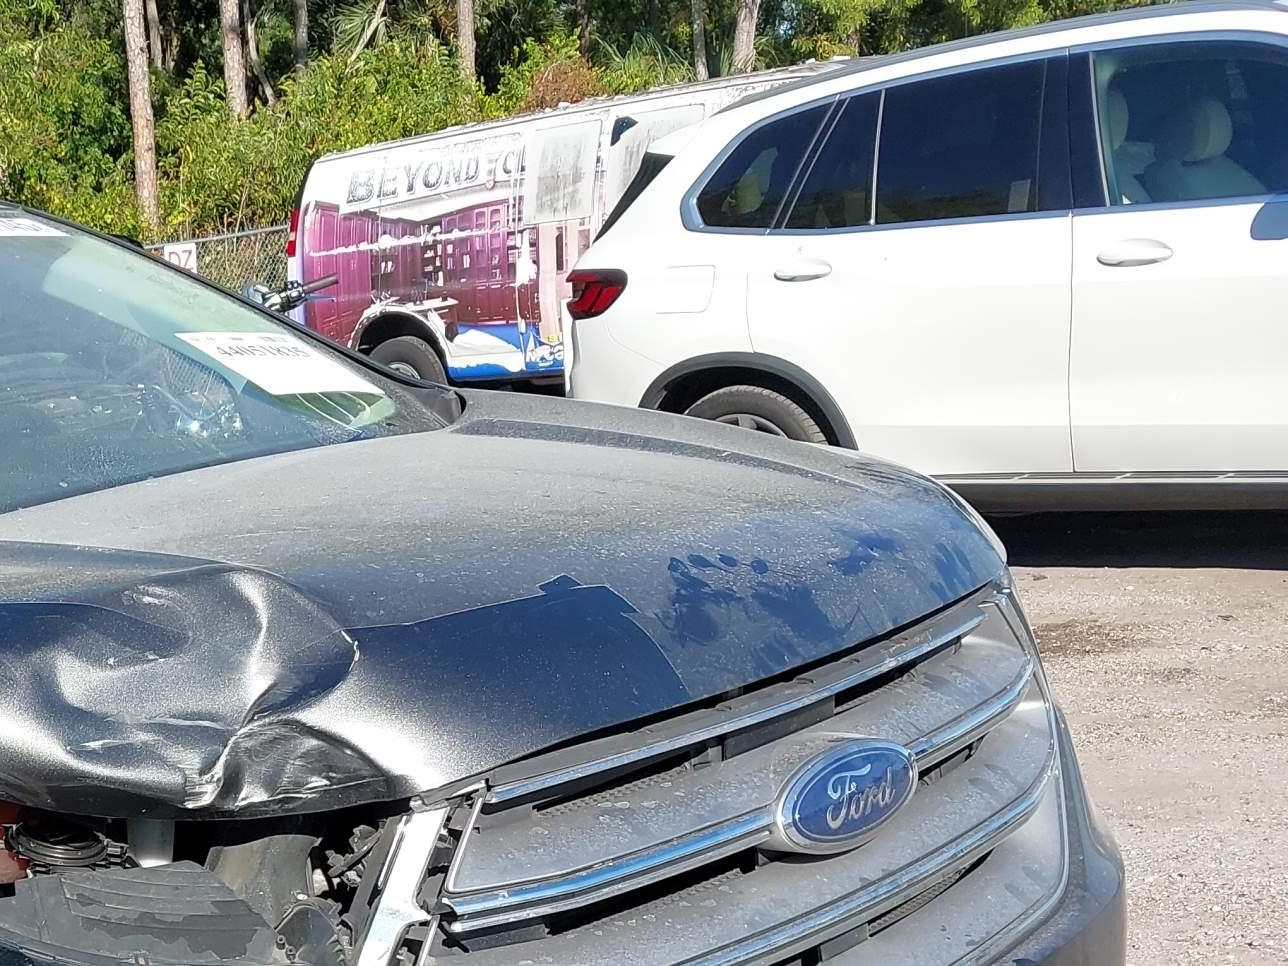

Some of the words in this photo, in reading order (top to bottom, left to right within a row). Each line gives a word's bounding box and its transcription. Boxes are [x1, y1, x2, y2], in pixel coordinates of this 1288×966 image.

[346, 154, 480, 204] BEYOND
[215, 345, 311, 358] 44051835
[826, 763, 897, 830] Ford
